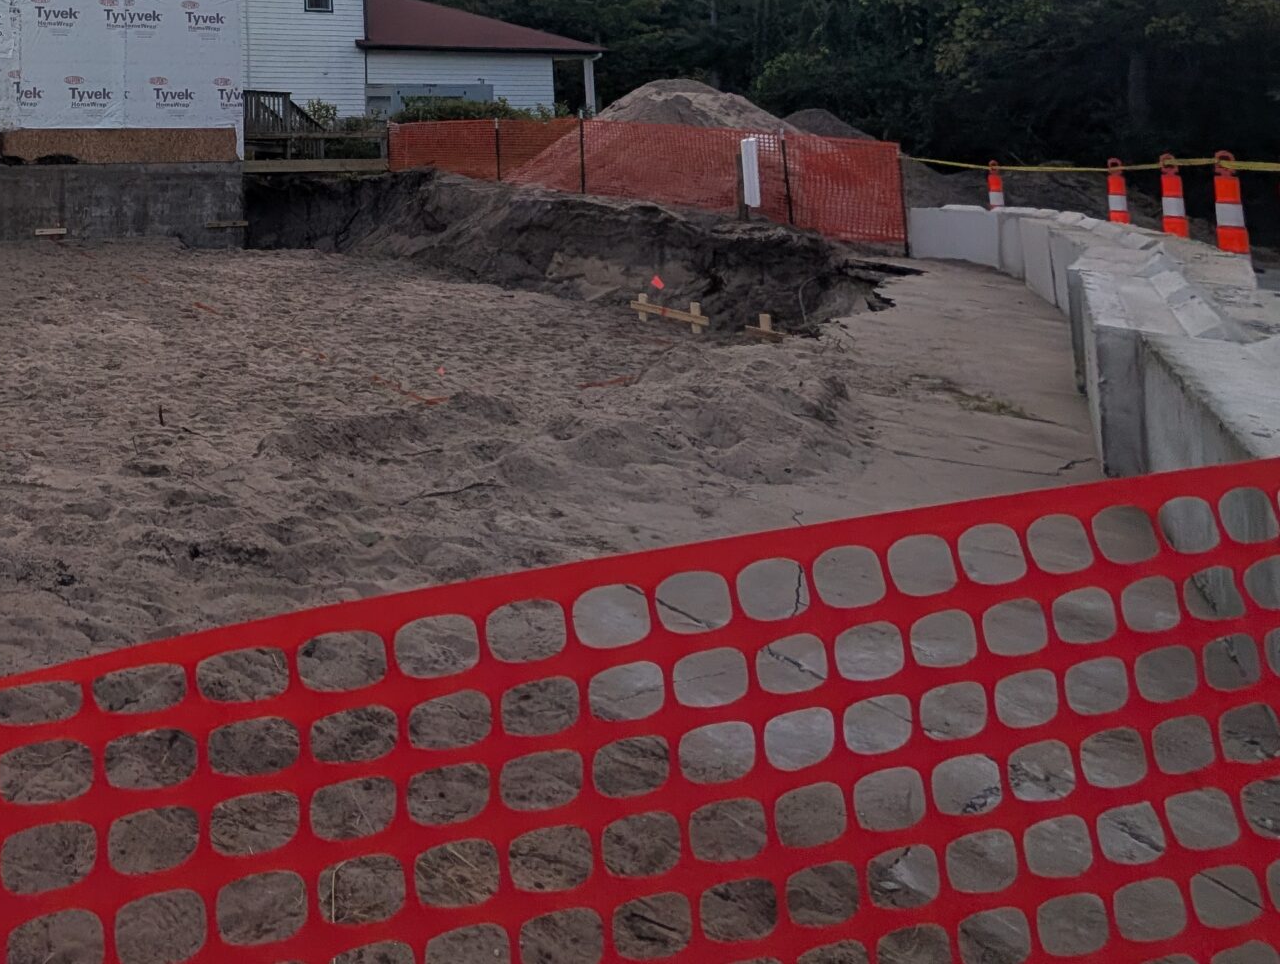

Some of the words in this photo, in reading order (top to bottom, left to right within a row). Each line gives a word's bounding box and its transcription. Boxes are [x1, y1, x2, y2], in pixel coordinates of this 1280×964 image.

[35, 6, 78, 21] Tyvek
[185, 12, 225, 26] Tyvek
[68, 87, 112, 102] Tyvek
[153, 88, 194, 102] Tyvek
